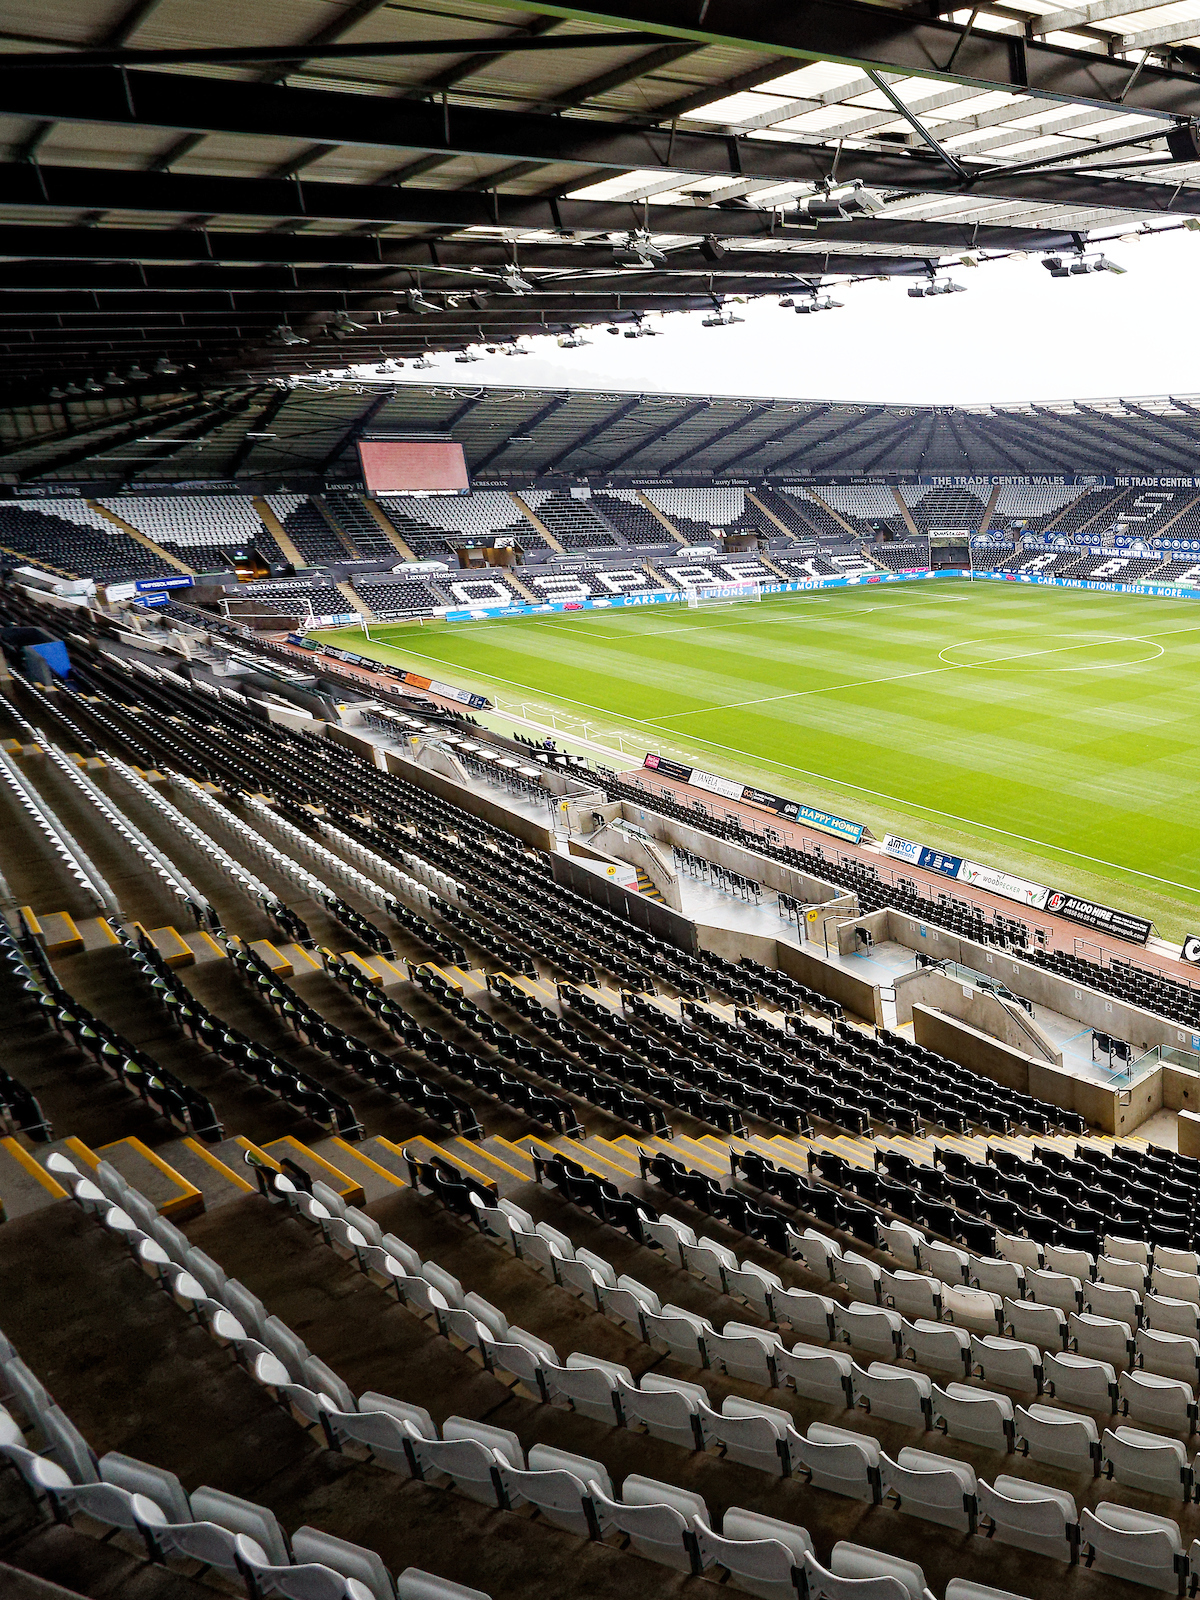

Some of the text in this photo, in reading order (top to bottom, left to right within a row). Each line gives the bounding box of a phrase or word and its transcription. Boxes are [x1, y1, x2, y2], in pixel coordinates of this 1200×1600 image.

[325, 482, 353, 492] Luxury
[932, 476, 1065, 485] THE TRADE CENTRE WALES
[1114, 477, 1129, 486] THE
[1131, 477, 1158, 487] TRADE
[1160, 477, 1192, 487] CENTRE
[12, 486, 81, 497] Luxury Living
[1142, 551, 1161, 559] WALES
[1038, 578, 1060, 586] CARS,
[1062, 579, 1084, 589] VANS,
[1087, 582, 1118, 592] LUTONS,
[1122, 584, 1145, 594] BUSES
[1148, 586, 1153, 594] &
[623, 595, 660, 606] CARS,
[704, 587, 747, 599] LUTONS,
[786, 583, 793, 591] &
[801, 807, 861, 835] HAPPY HOME
[982, 876, 1021, 893] WOODPECKER
[1065, 899, 1113, 921] A1 LOO HIRE
